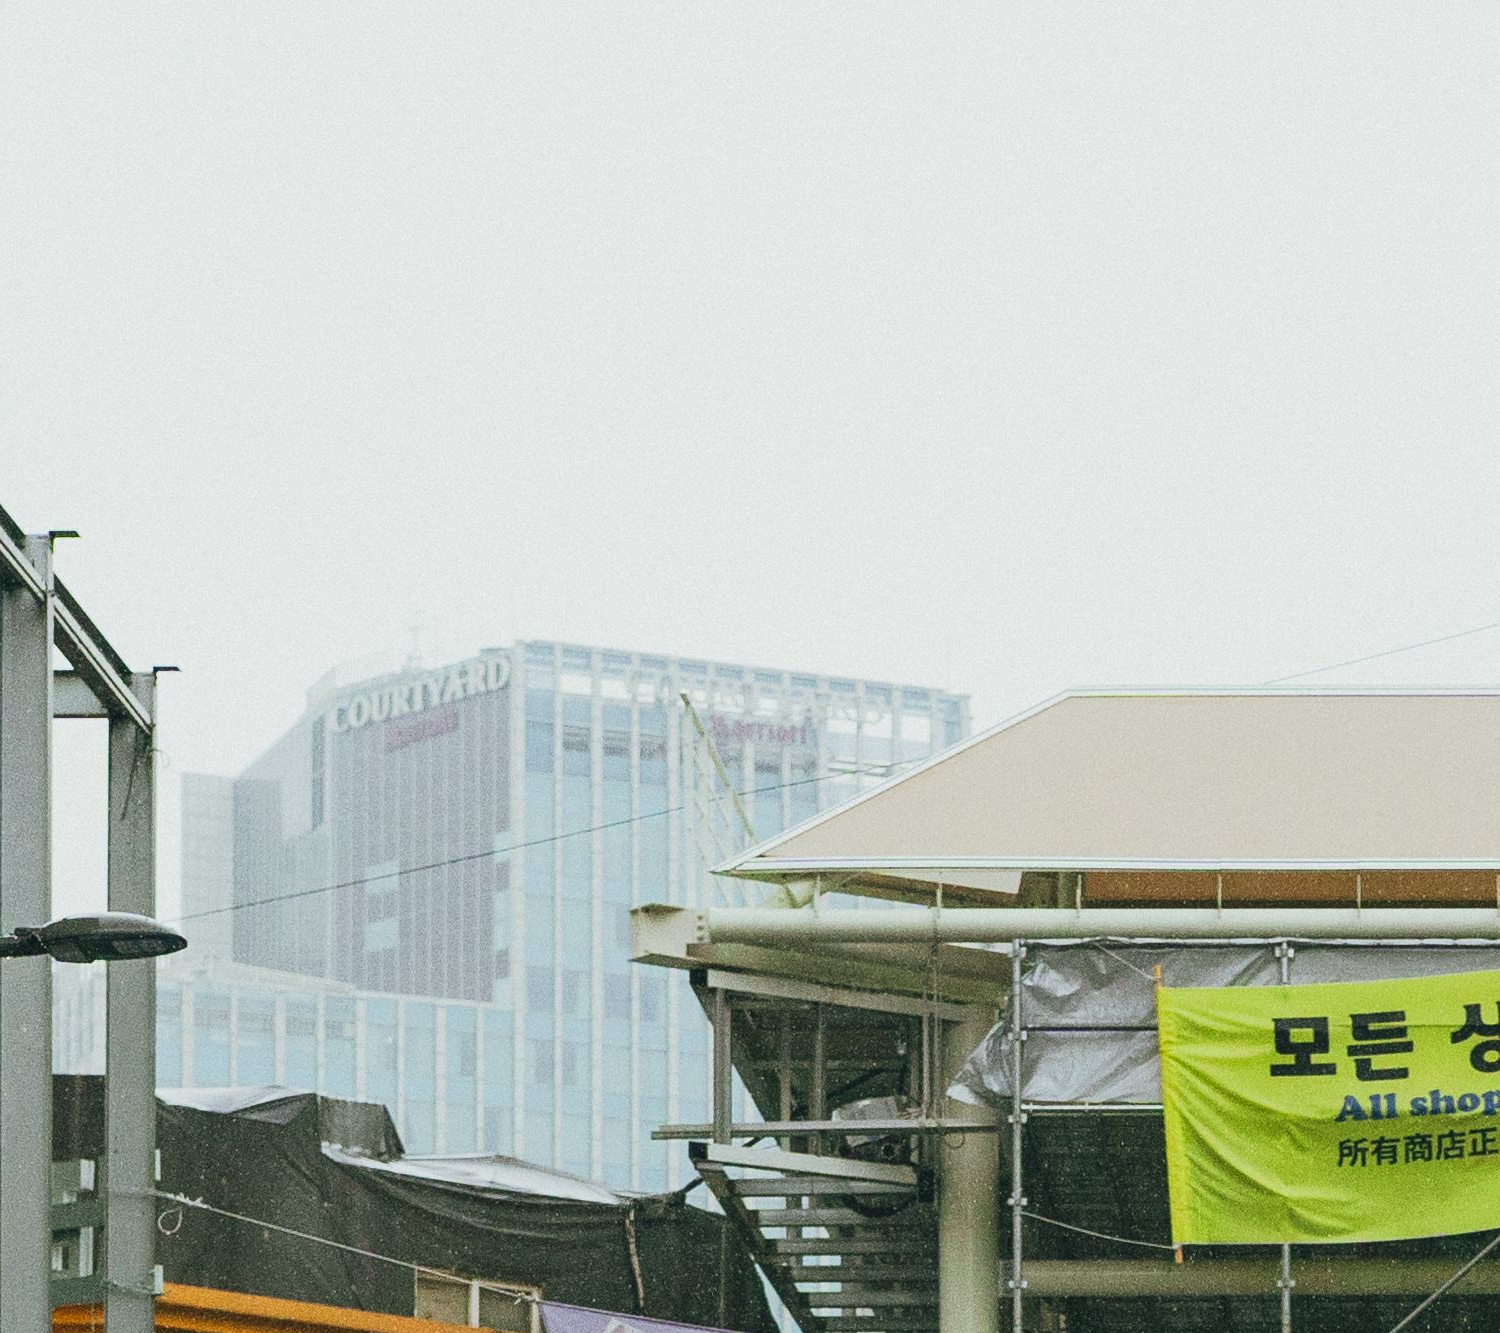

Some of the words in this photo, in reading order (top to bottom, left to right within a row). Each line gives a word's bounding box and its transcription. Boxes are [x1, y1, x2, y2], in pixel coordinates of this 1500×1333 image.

[329, 655, 512, 734] COURTYARD
[1269, 1010, 1414, 1082] 모든
[1334, 1092, 1398, 1122] All
